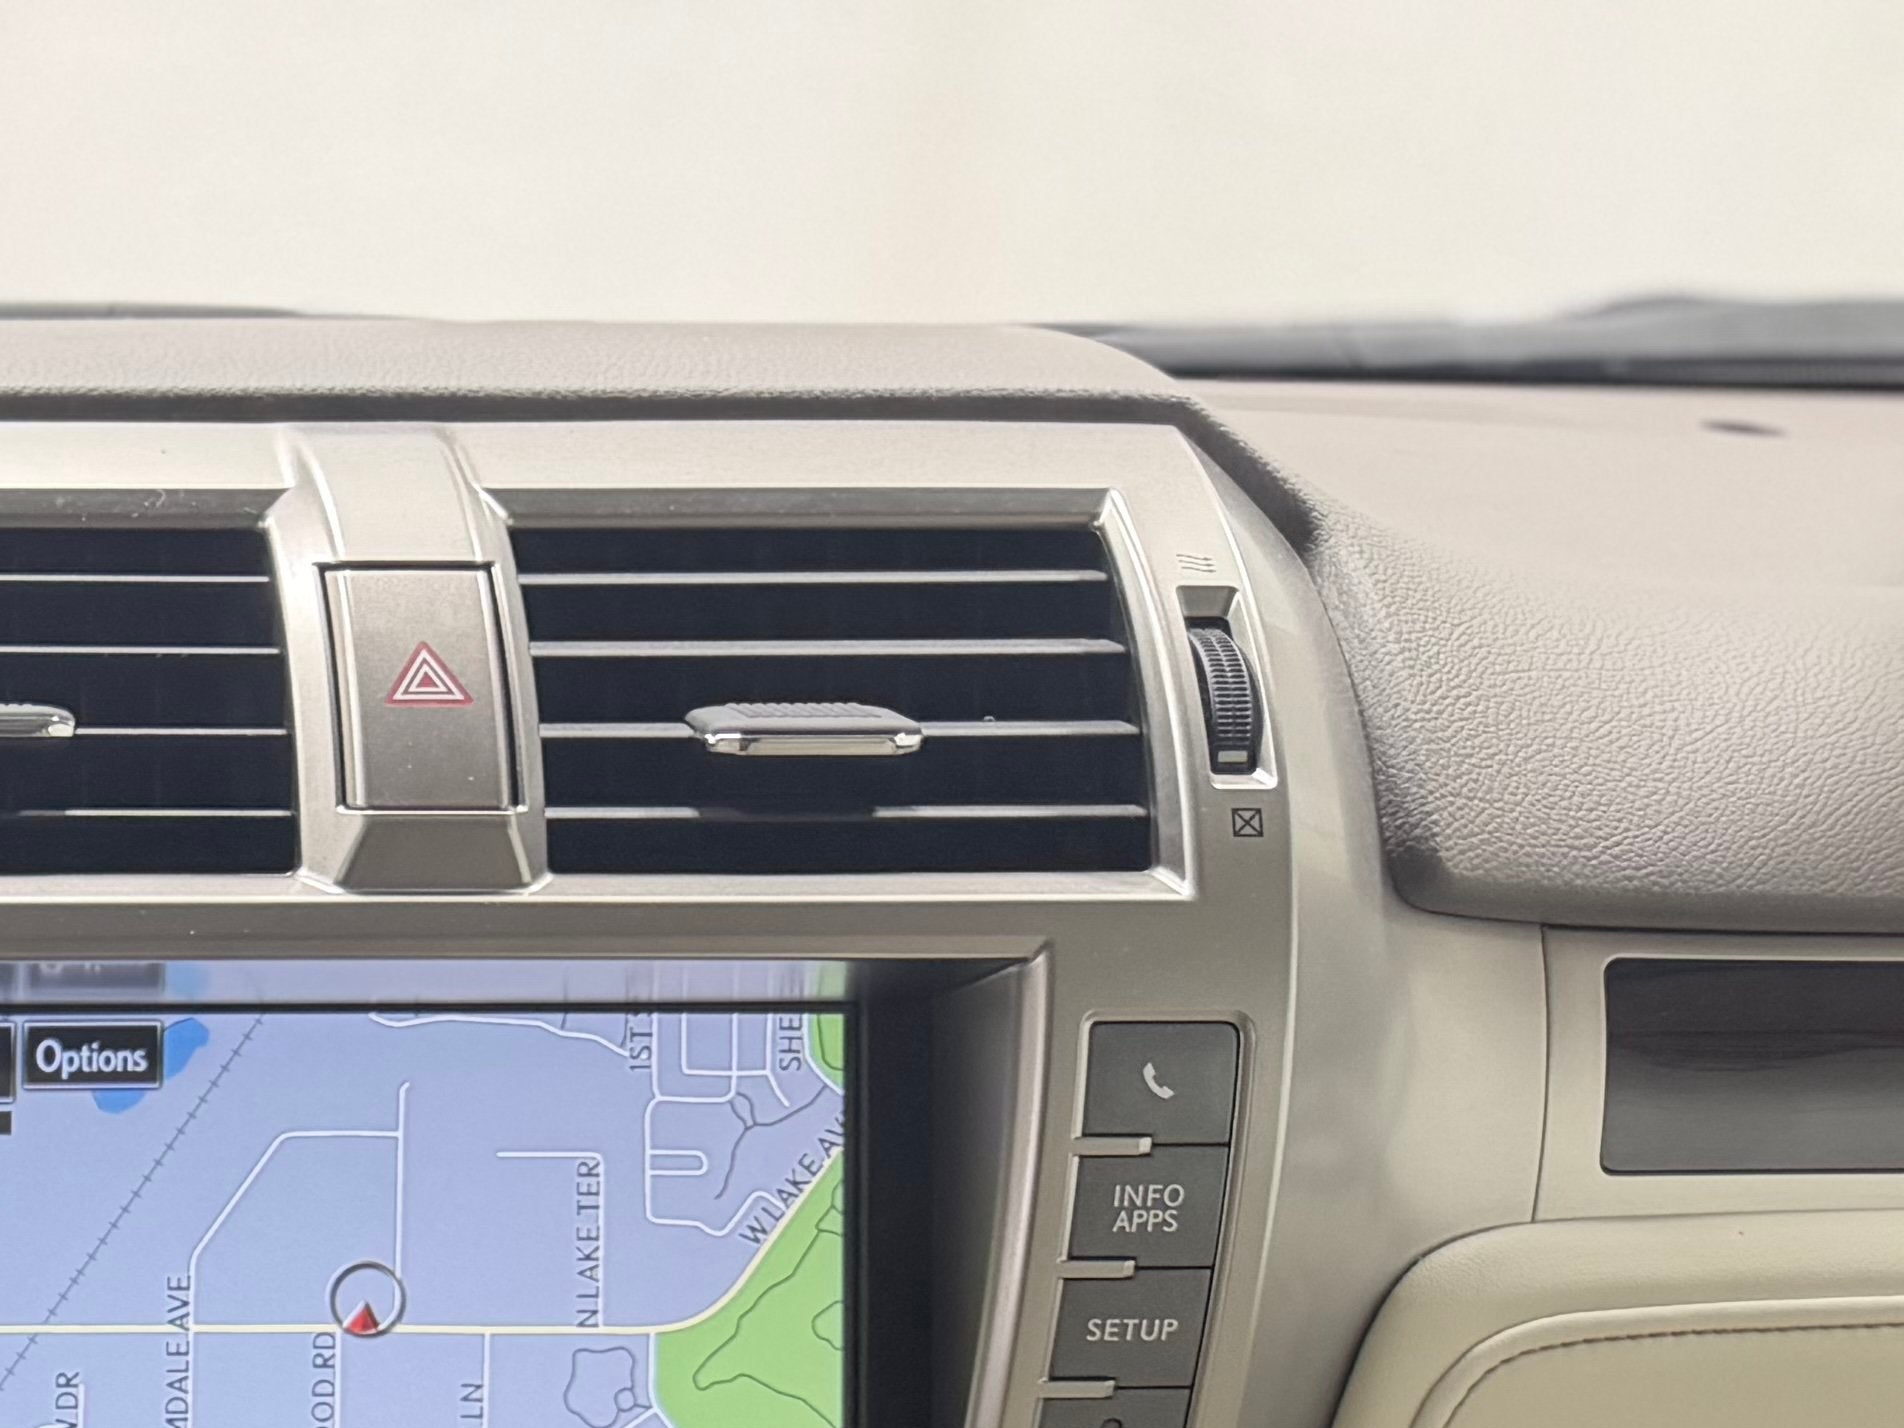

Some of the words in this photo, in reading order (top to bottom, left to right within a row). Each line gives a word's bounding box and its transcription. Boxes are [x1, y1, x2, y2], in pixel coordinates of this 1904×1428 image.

[36, 1039, 148, 1079] Options
[576, 1161, 600, 1216] TER
[738, 1215, 767, 1245] W
[761, 1152, 824, 1222] LAKE
[817, 1110, 844, 1159] AV
[1113, 1184, 1185, 1208] INFO
[1112, 1209, 1179, 1233] APPS
[576, 1226, 600, 1299] LAKE
[168, 1275, 191, 1331] AVE
[576, 1309, 599, 1328] N
[1086, 1318, 1179, 1342] SETUP
[312, 1332, 336, 1369] RD
[55, 1372, 79, 1409] DR
[461, 1383, 484, 1418] LN
